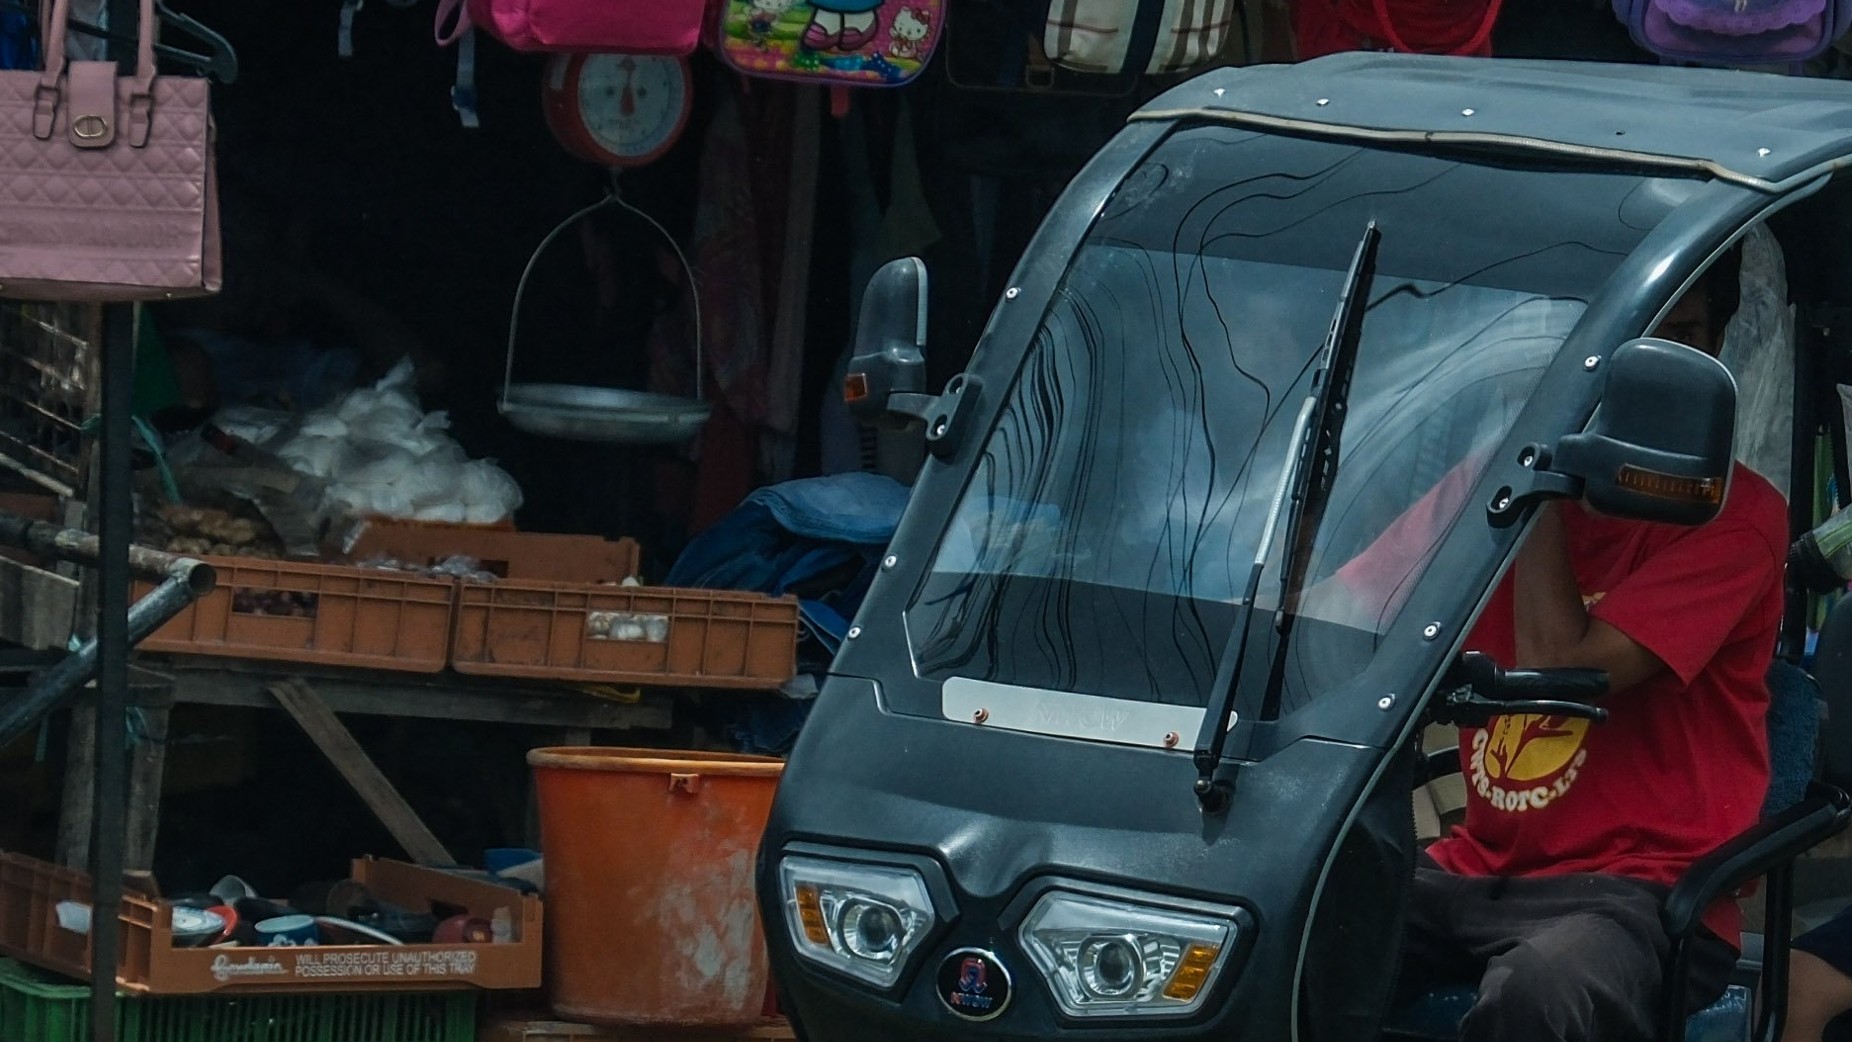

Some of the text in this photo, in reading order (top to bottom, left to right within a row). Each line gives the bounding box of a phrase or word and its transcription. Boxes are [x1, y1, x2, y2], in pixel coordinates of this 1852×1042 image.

[295, 950, 478, 966] WILL PROSECUTE UNAUTHORIZED
[294, 964, 363, 977] POSSESSION
[364, 964, 382, 976] OR
[382, 963, 404, 976] USE
[405, 963, 420, 975] OF
[420, 962, 447, 975] THIS
